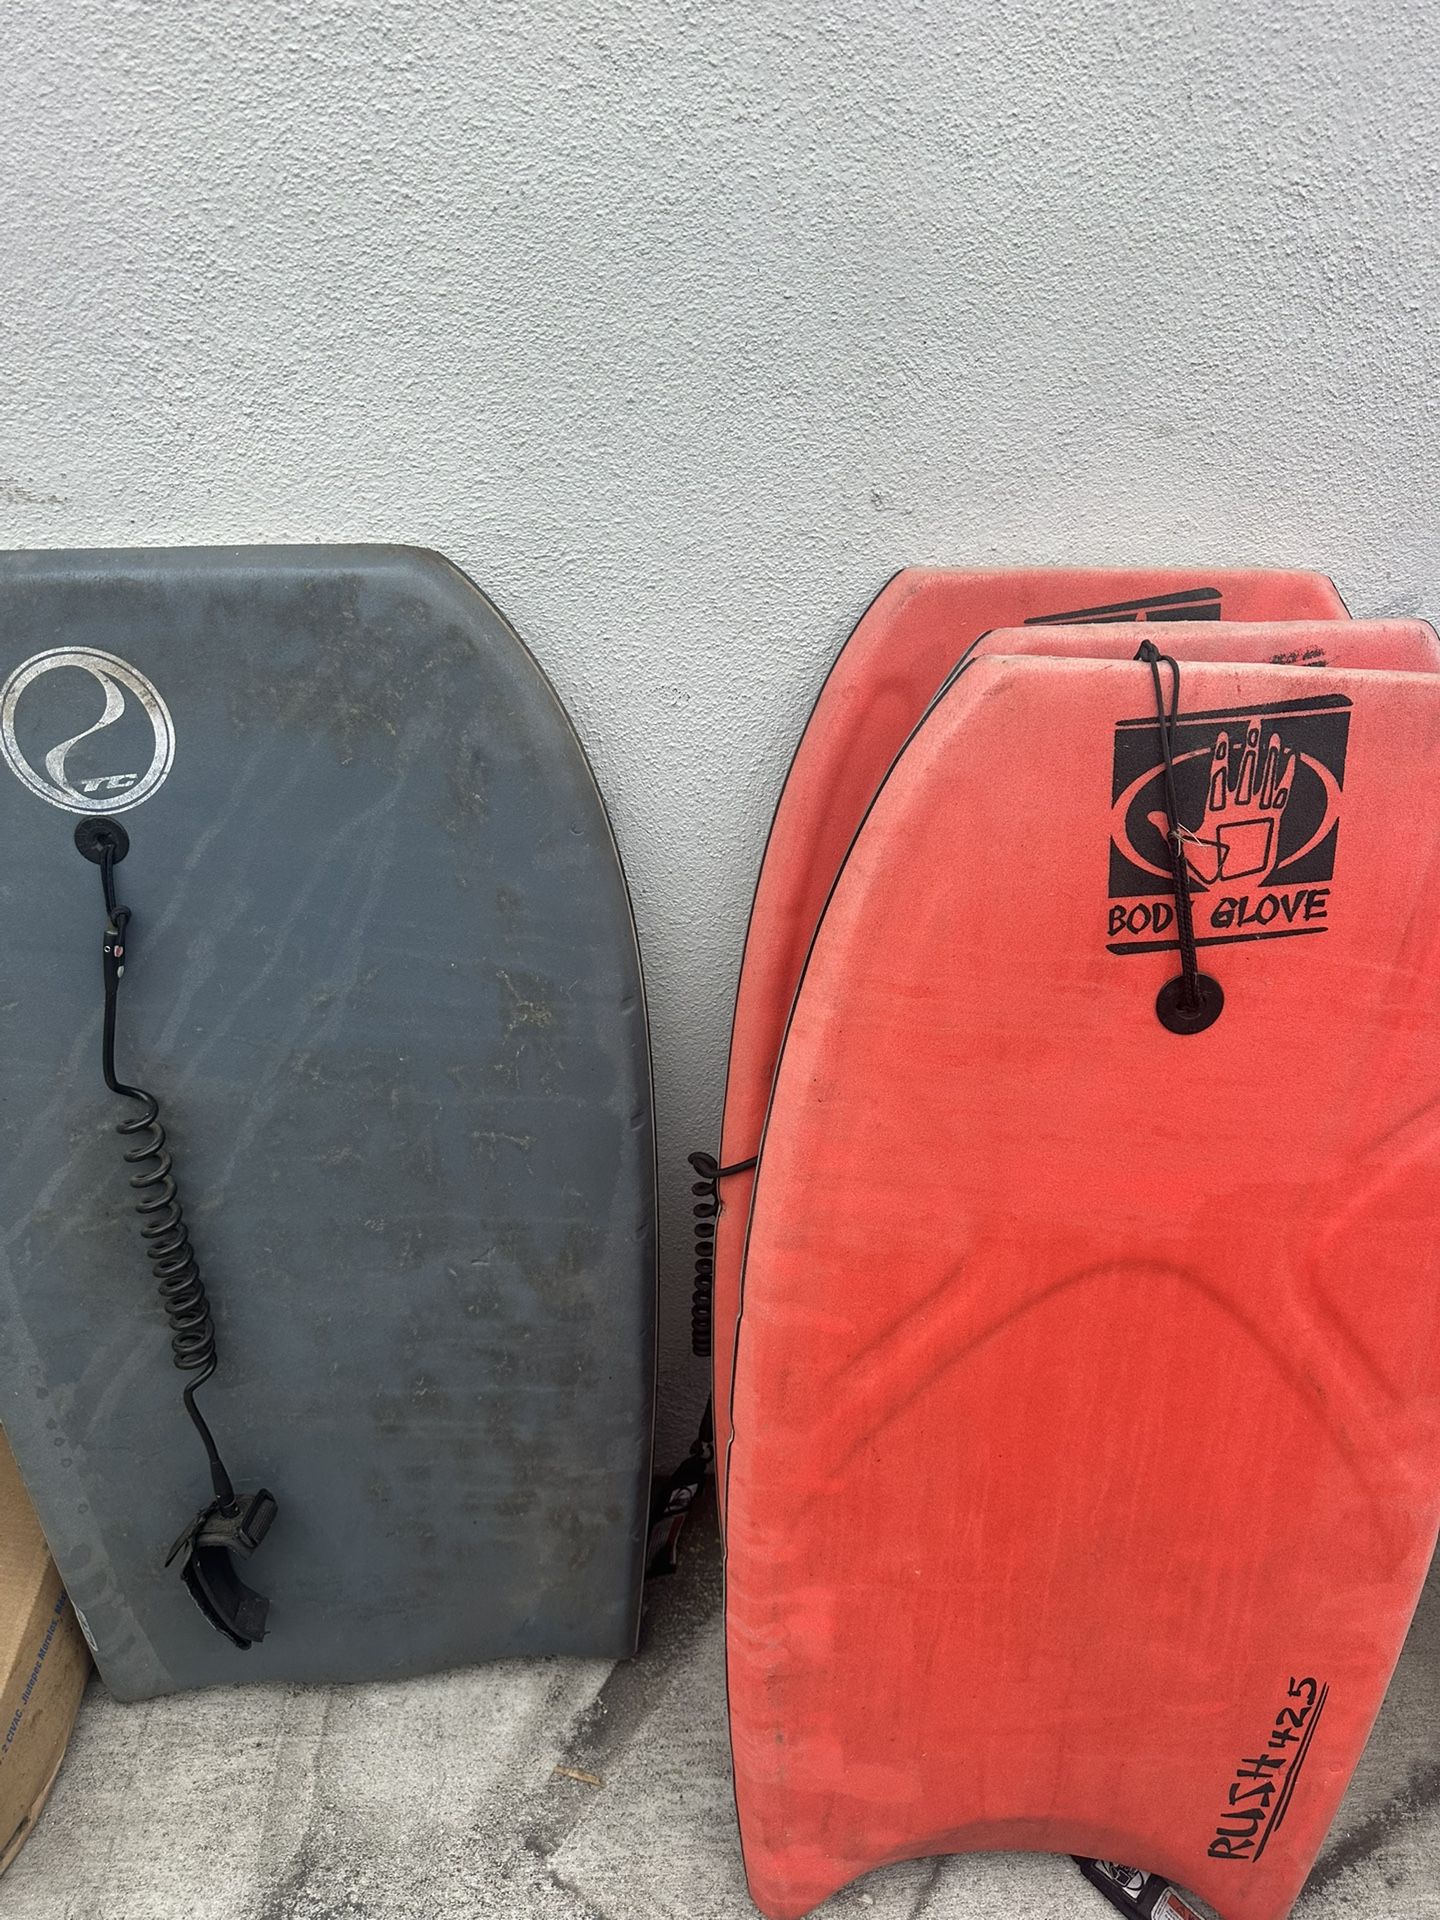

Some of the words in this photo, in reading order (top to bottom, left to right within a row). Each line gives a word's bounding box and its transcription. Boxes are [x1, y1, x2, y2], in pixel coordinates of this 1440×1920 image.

[1107, 902, 1195, 936] BOD
[1210, 888, 1331, 929] GLOVE
[6, 1708, 23, 1743] CIVAC
[1207, 1754, 1287, 1859] RUSH
